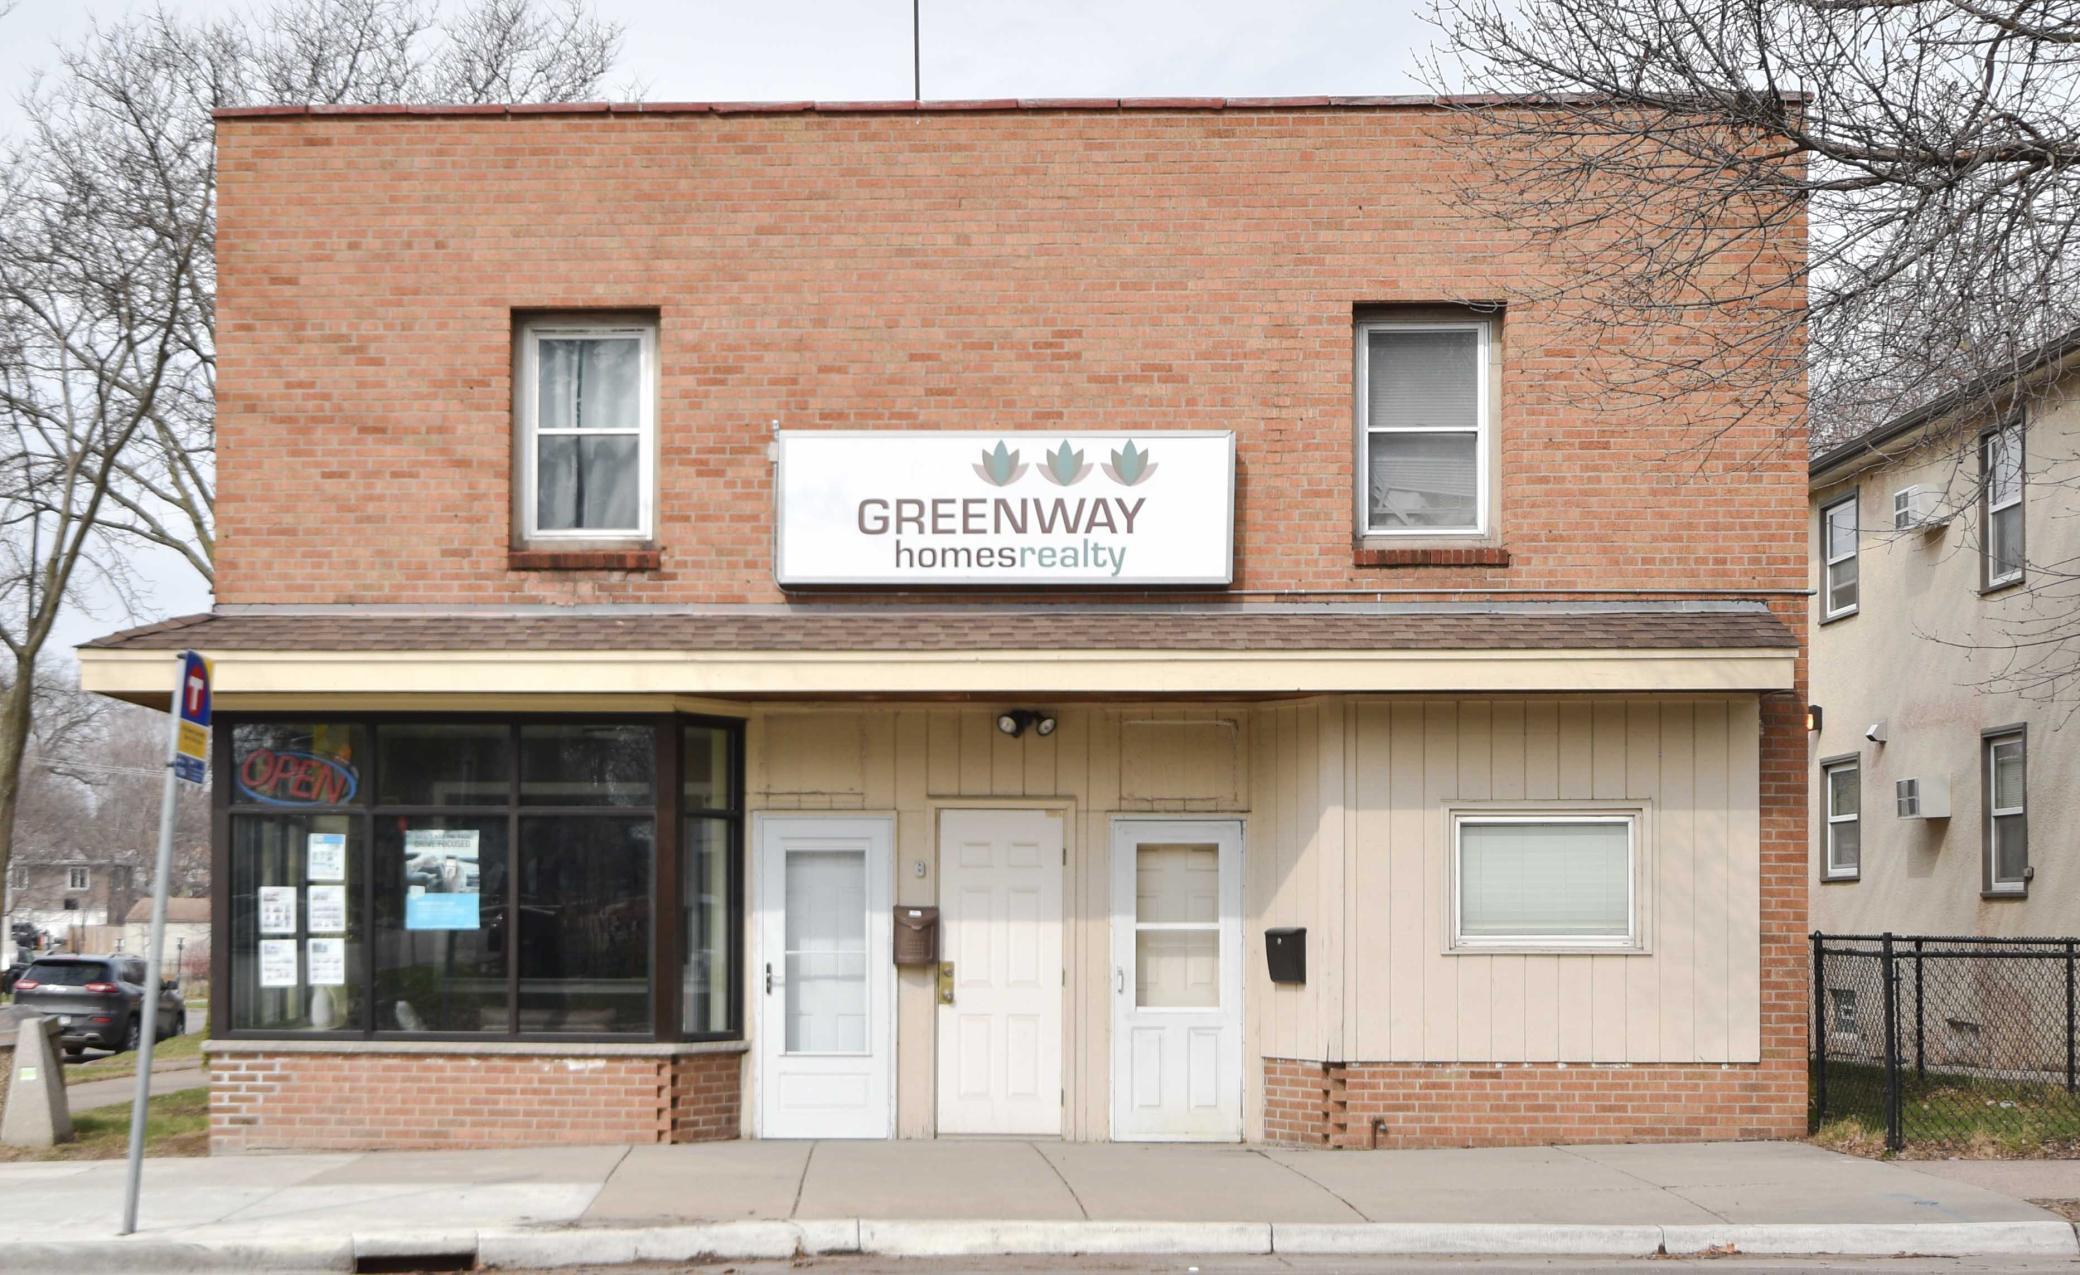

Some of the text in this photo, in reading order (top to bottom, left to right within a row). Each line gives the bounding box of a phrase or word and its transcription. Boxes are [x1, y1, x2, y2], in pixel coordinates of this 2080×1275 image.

[858, 497, 1146, 535] GREENWAY
[895, 538, 1126, 577] homesrealty
[188, 675, 204, 711] T
[242, 747, 346, 805] OPEN
